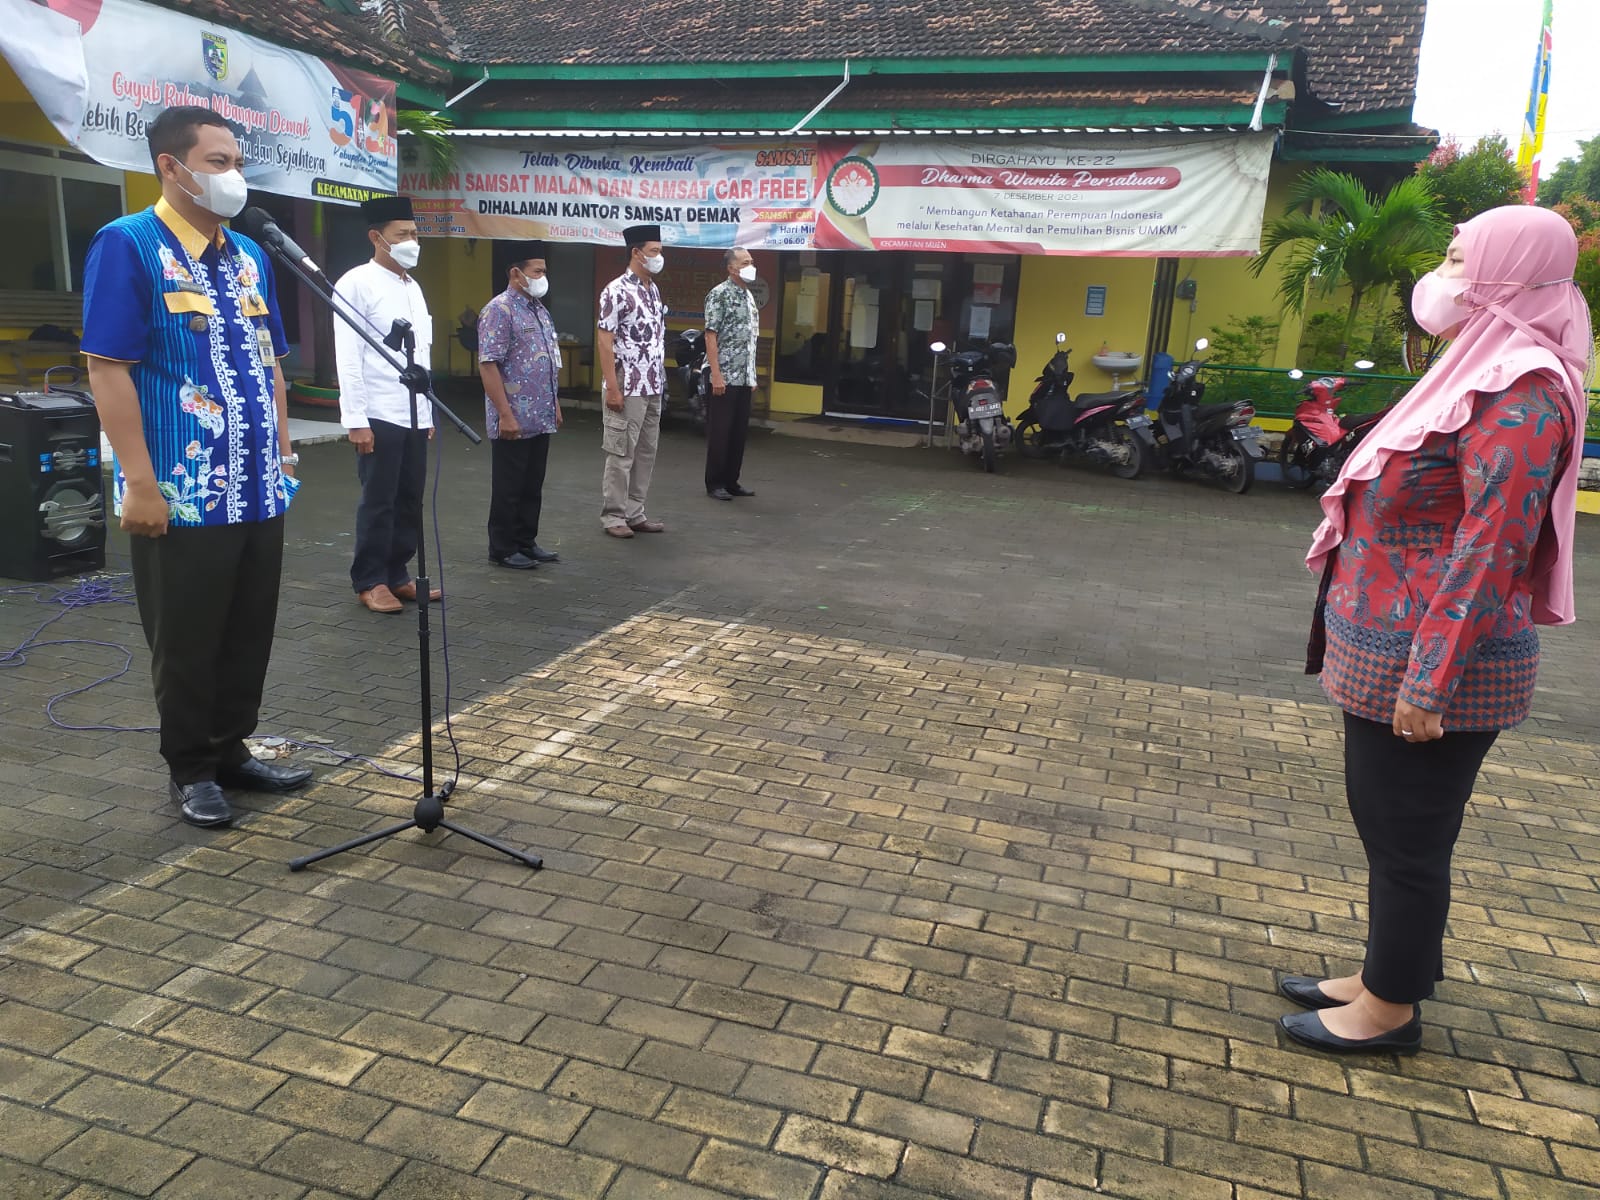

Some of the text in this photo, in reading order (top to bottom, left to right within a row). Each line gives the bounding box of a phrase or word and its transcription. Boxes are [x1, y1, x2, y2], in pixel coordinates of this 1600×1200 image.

[112, 71, 160, 107] Guyub
[212, 93, 267, 133] Mbangun
[269, 110, 311, 137] Demak
[254, 136, 273, 160] dan
[276, 143, 326, 173] Sejahtera
[755, 150, 816, 166] SAMSAT
[971, 153, 1115, 166] DIRGAHAYU KE-22
[520, 151, 695, 174] Telah Dibuka Kembali
[921, 167, 1167, 188] Dharma Wanita Persatuan
[317, 182, 369, 203] KECAMATAN
[465, 173, 530, 193] SAMSAT
[534, 174, 593, 196] MALAM
[598, 178, 633, 198] DAN
[638, 178, 711, 199] SAMSAT
[715, 179, 752, 199] CAR
[759, 178, 807, 199] FREE
[1004, 192, 1053, 200] DESEMBER
[479, 199, 740, 223] DIHALAMAN KANTOR SAMSAT DEMAK
[759, 211, 793, 220] SAMSAT
[926, 206, 988, 218] Membangun
[990, 208, 1044, 219] Ketahanan
[1047, 209, 1107, 221] Perempuan
[1111, 210, 1163, 220] Indonesia
[550, 225, 579, 237] Mulai
[780, 225, 798, 234] Hari
[896, 220, 932, 230] melalui
[934, 221, 984, 232] Kesehatan
[986, 222, 1024, 233] Mental
[1026, 224, 1044, 234] dan
[1047, 224, 1102, 235] Pemulihan
[1105, 225, 1136, 235] Bisnis
[1138, 225, 1178, 235] UMKM
[880, 240, 924, 249] KECAMATAN
